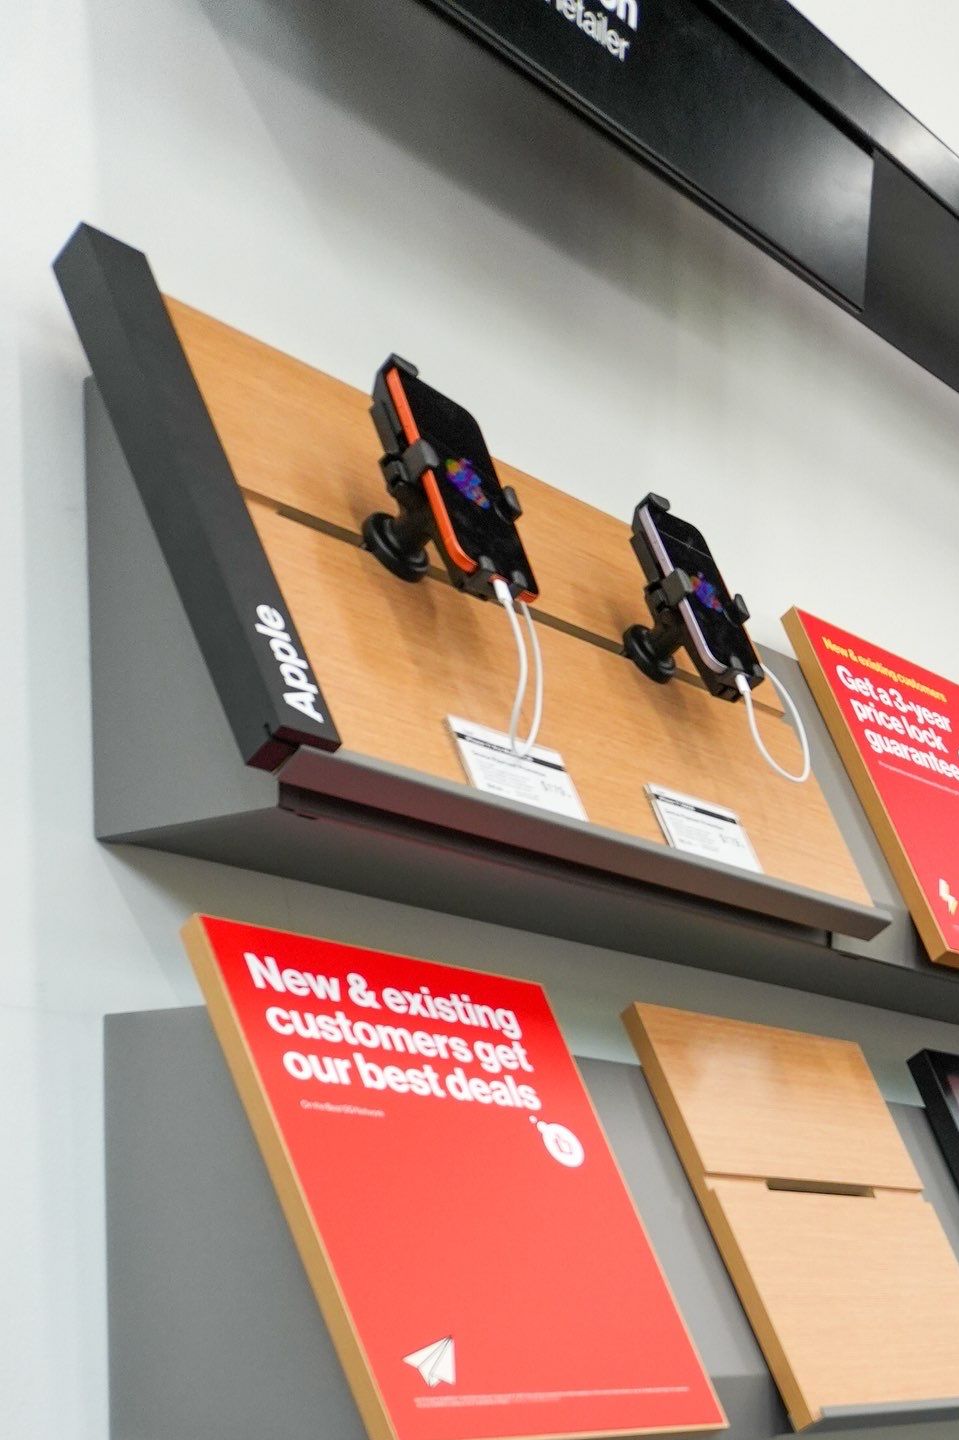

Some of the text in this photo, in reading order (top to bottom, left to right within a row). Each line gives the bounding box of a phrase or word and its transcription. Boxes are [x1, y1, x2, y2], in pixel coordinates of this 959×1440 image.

[545, 0, 630, 62] etailer
[254, 604, 324, 723] Apple
[836, 665, 952, 733] Get a 3-year
[850, 699, 949, 753] price lock
[244, 952, 522, 1040] New & existing
[265, 1006, 534, 1073] customers get
[282, 1051, 541, 1110] our best deals
